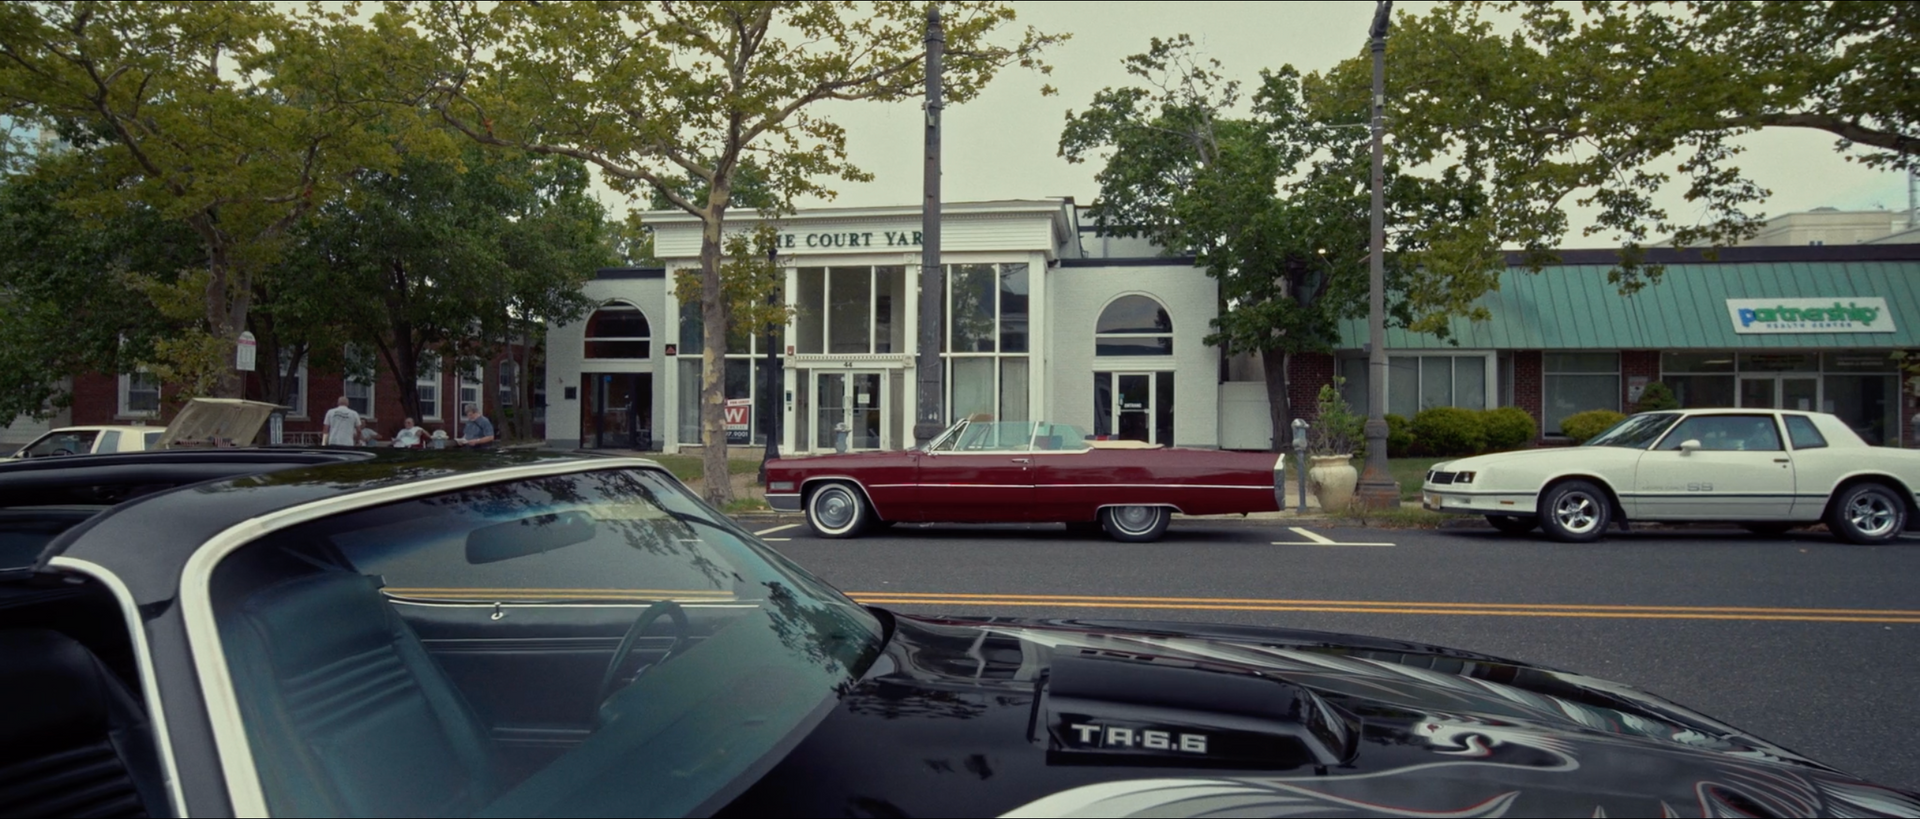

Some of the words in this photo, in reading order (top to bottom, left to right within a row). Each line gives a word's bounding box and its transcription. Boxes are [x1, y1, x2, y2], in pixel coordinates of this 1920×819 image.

[806, 232, 873, 248] COURT
[884, 231, 923, 246] YAR
[1738, 302, 1878, 328] partnership
[1687, 482, 1714, 492] SS
